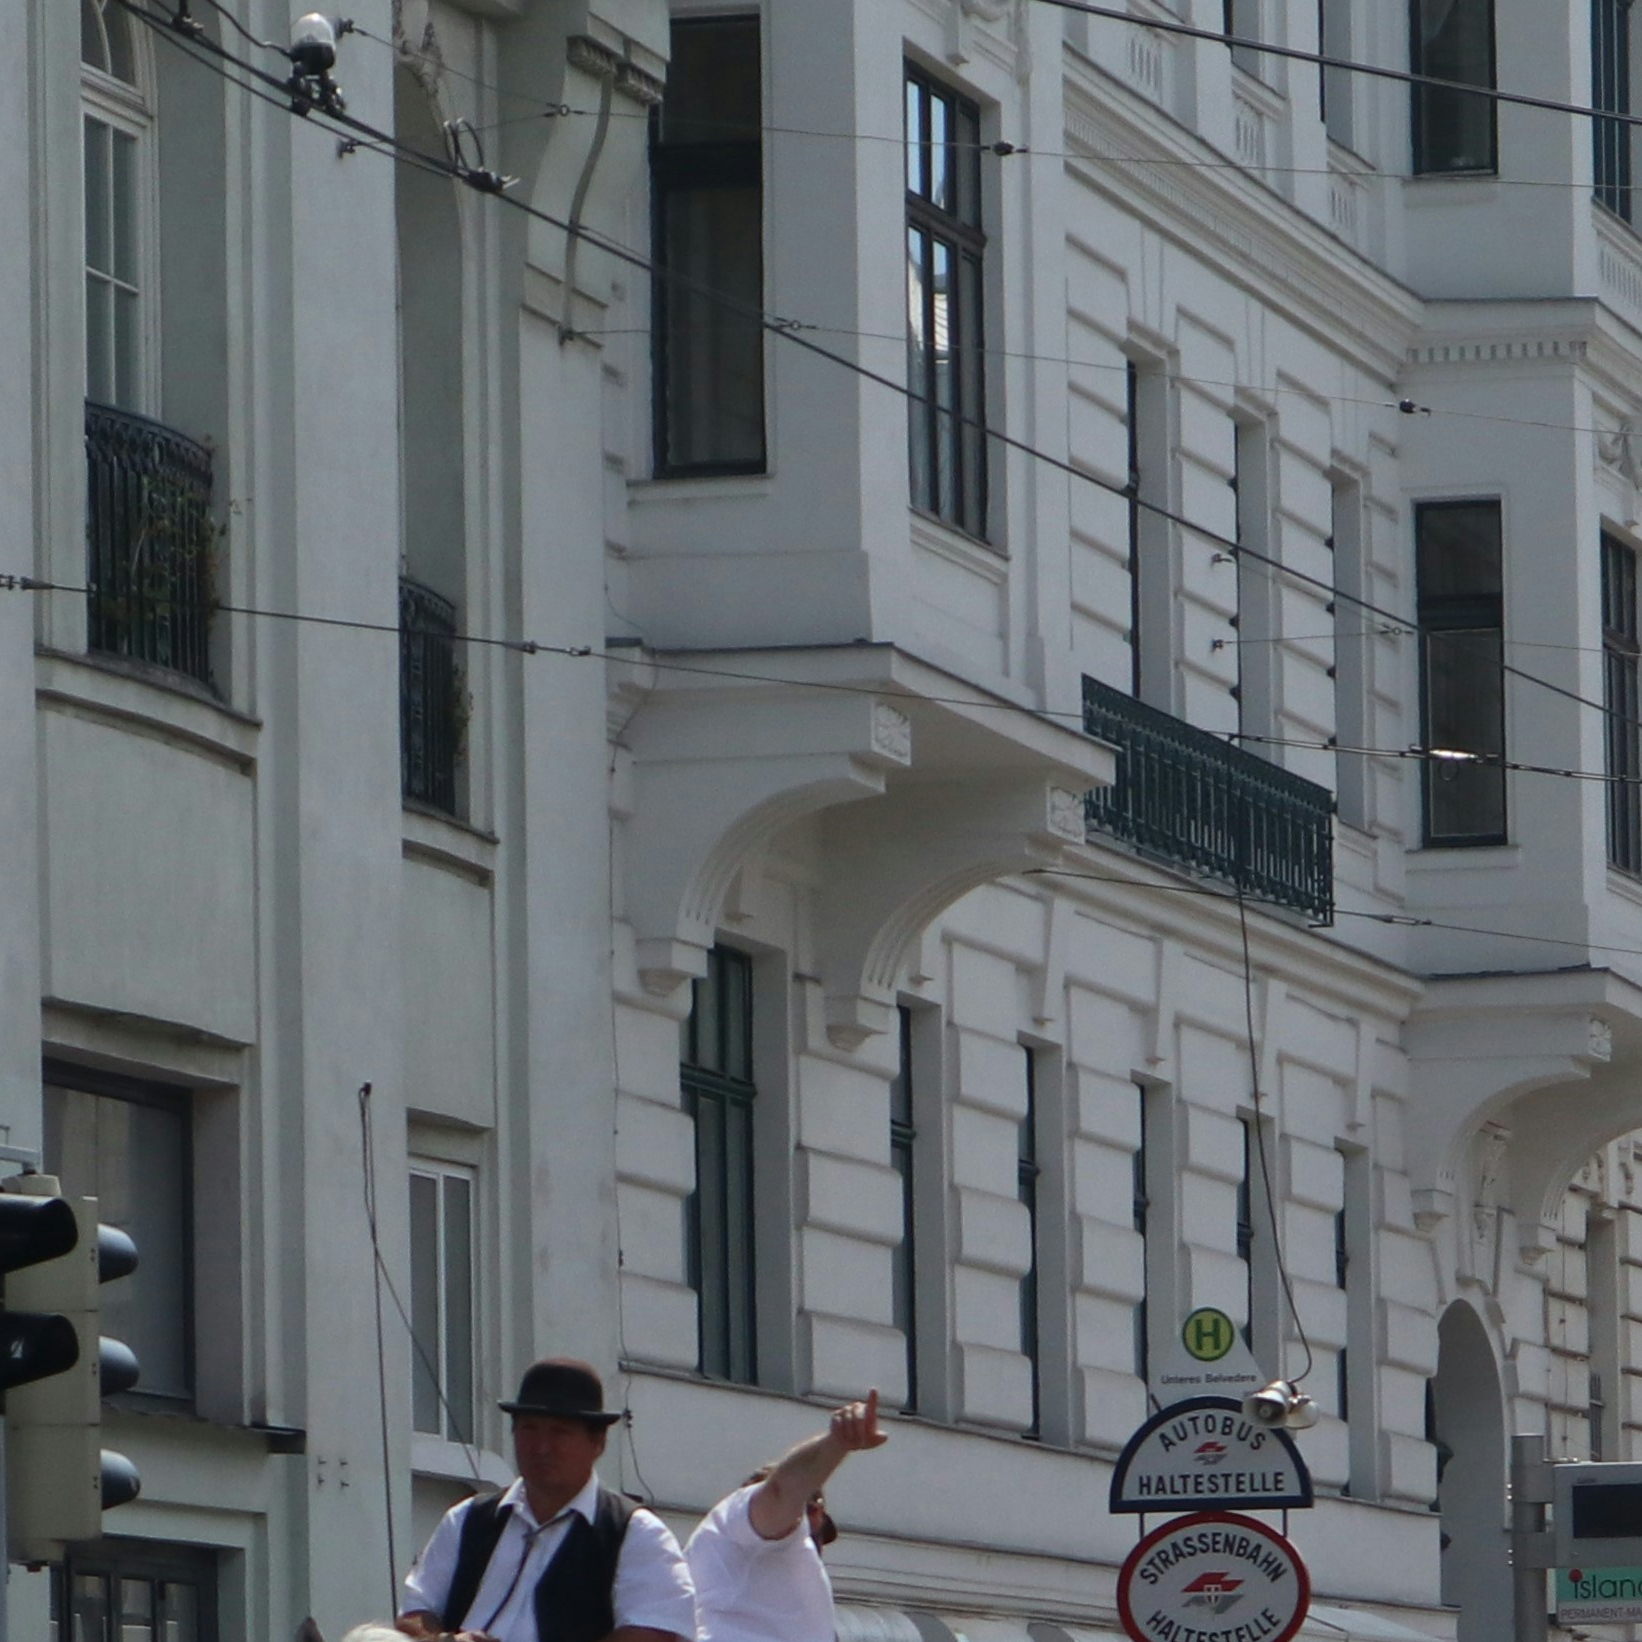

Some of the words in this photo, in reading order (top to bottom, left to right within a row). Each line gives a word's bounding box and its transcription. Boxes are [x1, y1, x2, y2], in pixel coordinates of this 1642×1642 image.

[1195, 1317, 1222, 1351] H
[1160, 1374, 1201, 1385] Unteres
[1205, 1373, 1257, 1384] Belvedere
[1158, 1413, 1267, 1453] AUTOBUS
[1137, 1471, 1286, 1496] HALTESTELLE
[1139, 1531, 1288, 1586] STRASSENBAHN
